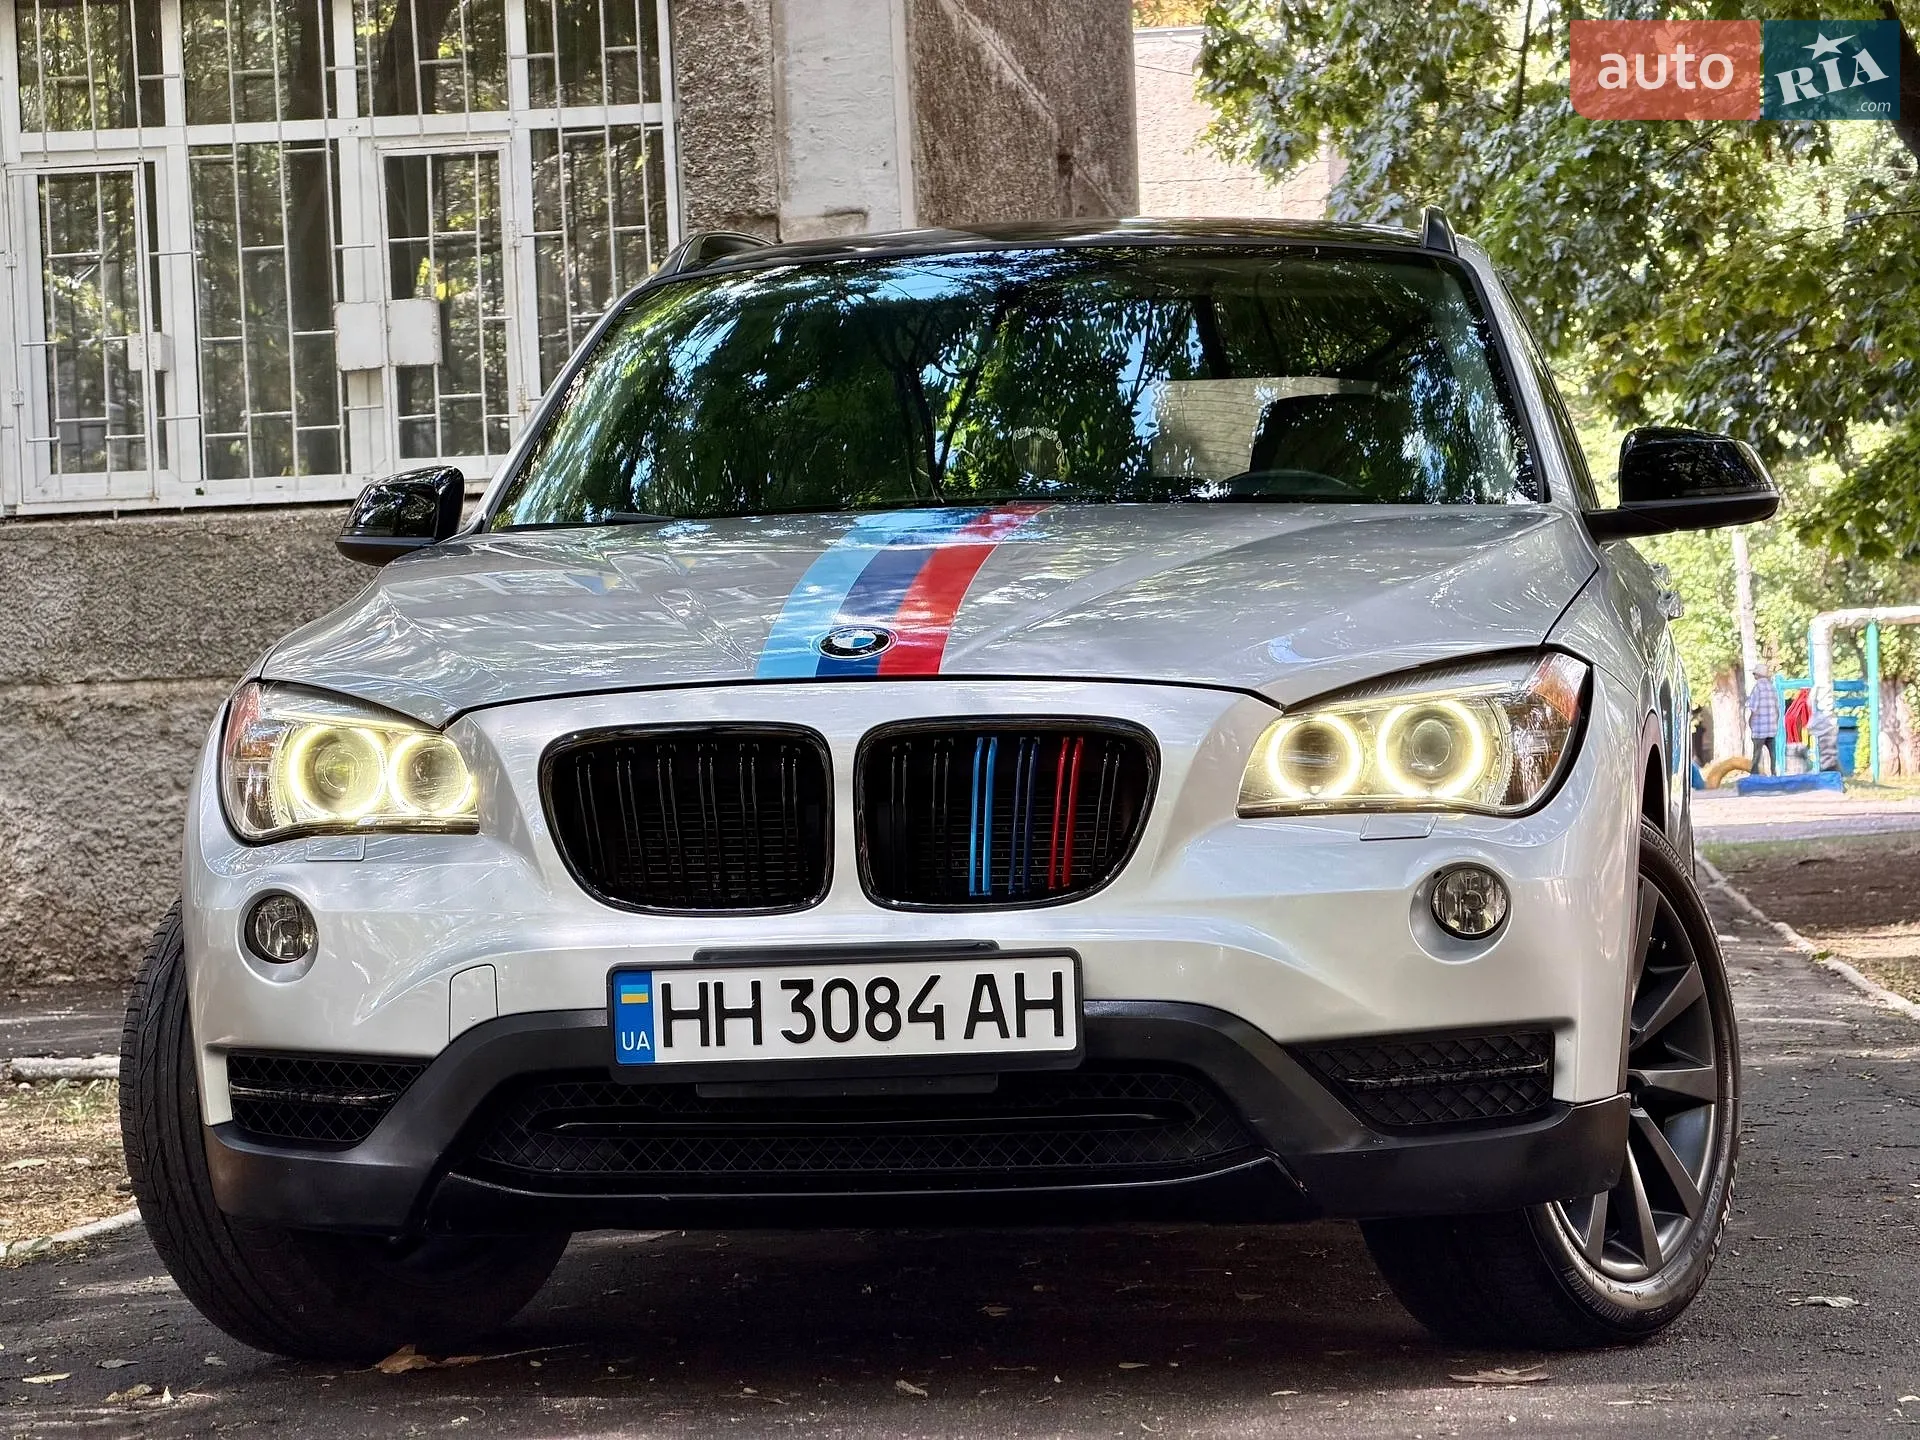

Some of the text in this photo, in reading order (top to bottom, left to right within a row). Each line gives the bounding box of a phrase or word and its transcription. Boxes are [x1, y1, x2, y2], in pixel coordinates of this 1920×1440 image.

[661, 971, 1064, 1047] HH 3084 AH
[621, 1031, 651, 1051] UA
